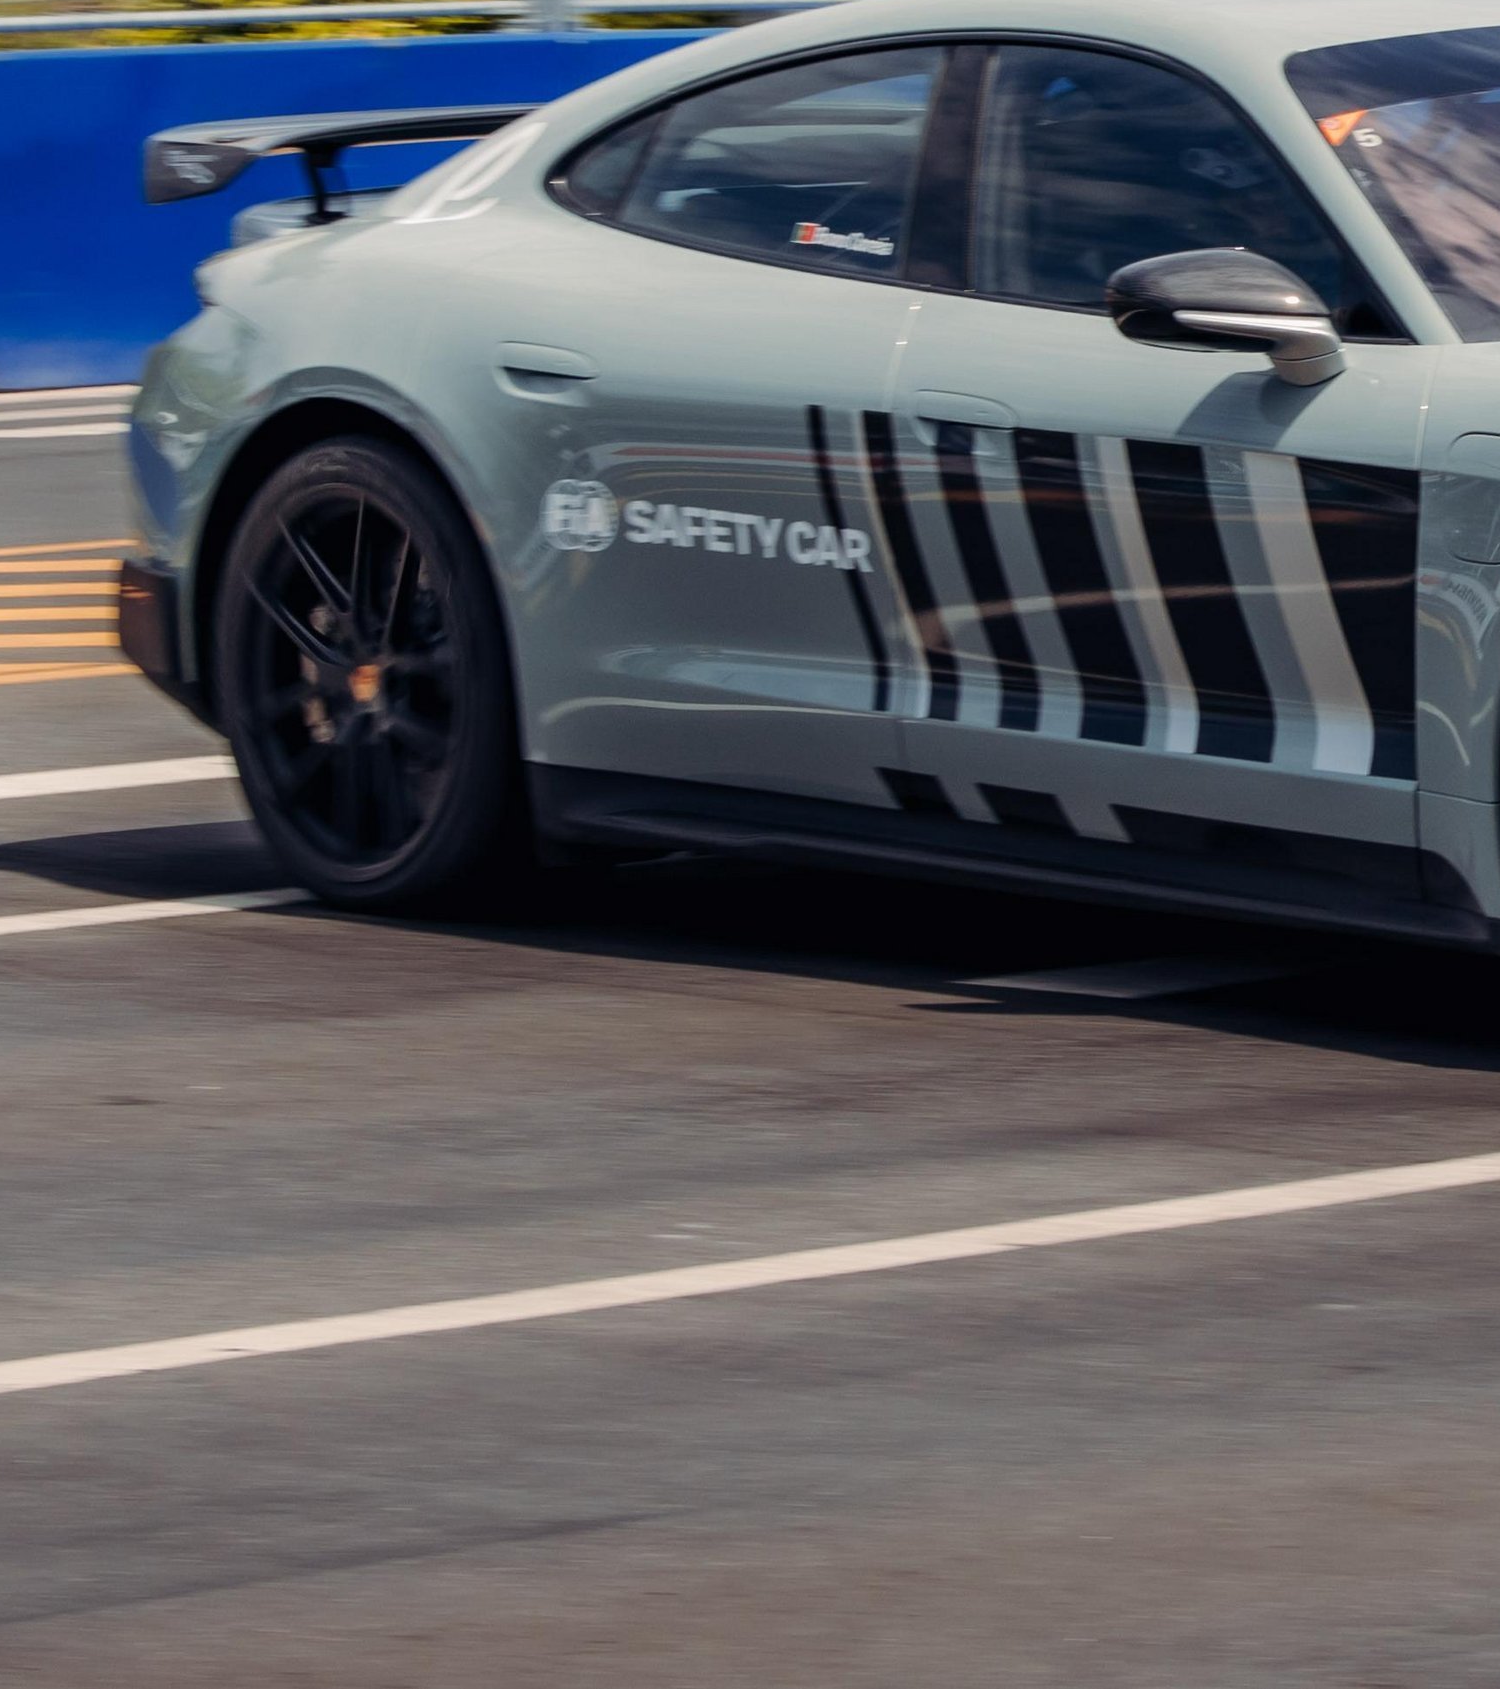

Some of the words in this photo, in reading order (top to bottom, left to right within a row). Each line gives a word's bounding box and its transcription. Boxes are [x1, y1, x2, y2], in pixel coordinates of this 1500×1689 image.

[1352, 128, 1383, 147] 5
[623, 499, 783, 559] SAFETY
[785, 520, 875, 573] CAR
